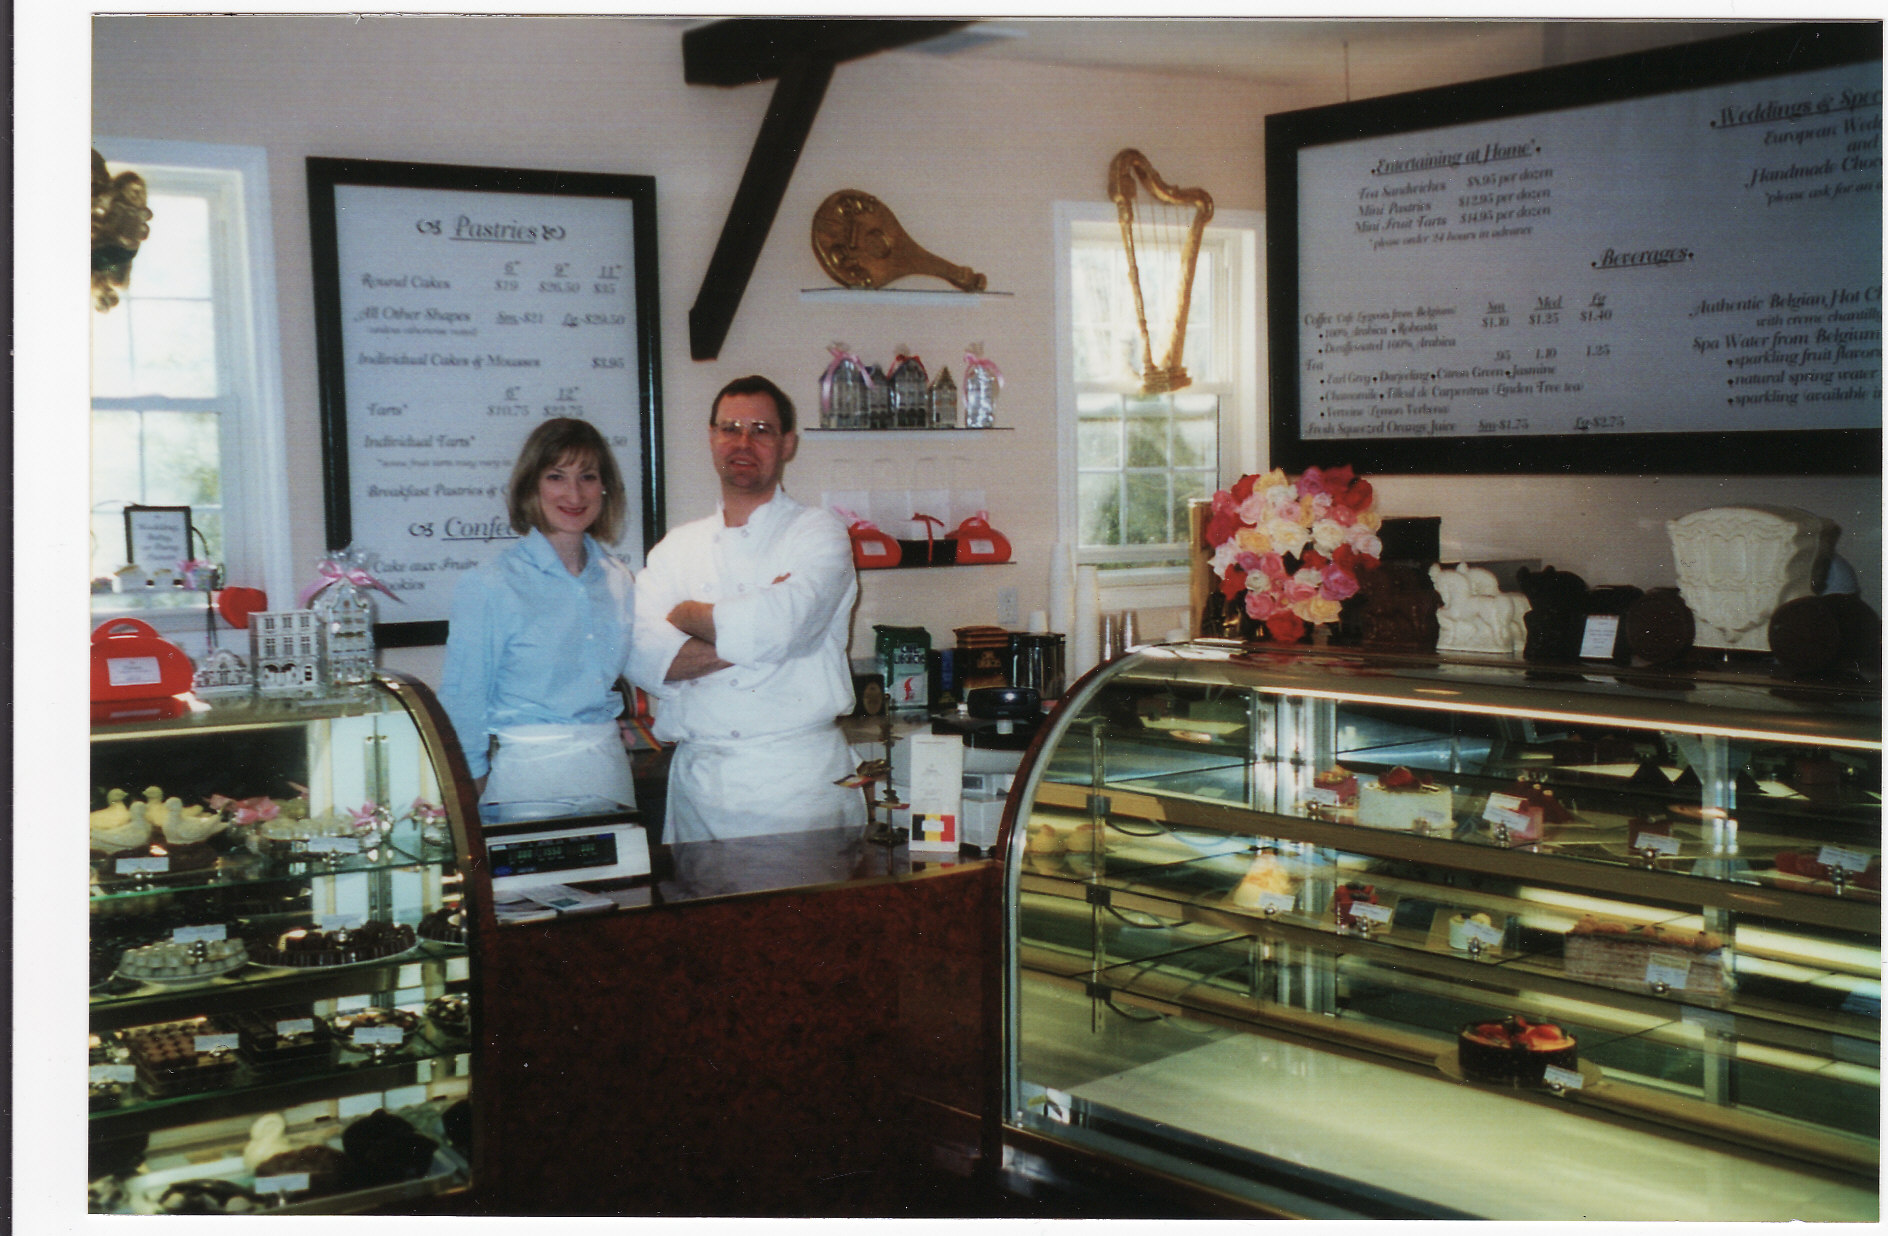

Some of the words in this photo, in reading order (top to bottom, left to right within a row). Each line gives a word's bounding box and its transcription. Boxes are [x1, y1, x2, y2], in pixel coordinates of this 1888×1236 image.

[1720, 101, 1812, 124] Weddings
[1764, 127, 1837, 146] European
[1847, 133, 1879, 152] and
[1375, 150, 1463, 173] Entertaining
[1465, 148, 1481, 163] at
[1745, 159, 1838, 189] Handmade
[1358, 187, 1379, 200] Tea
[1382, 179, 1447, 197] Sandwiches
[1498, 172, 1516, 187] per
[1519, 167, 1553, 182] dozen
[1807, 184, 1831, 199] ask
[1831, 182, 1854, 199] for
[1358, 204, 1384, 216] Mini
[1388, 201, 1432, 214] Pastries
[1458, 194, 1494, 207] $12.95
[1495, 192, 1515, 206] per
[1516, 187, 1551, 200] dozen
[455, 214, 538, 241] Pastries
[1356, 222, 1380, 233] Mini
[1383, 218, 1413, 230] Fruit
[1416, 214, 1447, 227] Tarts
[1459, 211, 1494, 224] $14.95
[1495, 209, 1515, 223] per
[1516, 205, 1551, 218] dozen
[1446, 231, 1477, 242] hours
[1601, 248, 1688, 267] Beverages
[361, 272, 408, 288] Round
[411, 275, 451, 288] Cakes
[1534, 294, 1563, 311] Med
[1688, 296, 1764, 319] Authentic
[1770, 293, 1826, 311] Belgian
[1826, 288, 1860, 308] Hot
[382, 307, 421, 320] Other
[425, 308, 471, 323] Shapes
[1304, 312, 1332, 328] Coffee
[1528, 312, 1559, 325] $1.25
[1579, 309, 1613, 322] $1.40
[1756, 314, 1784, 327] with
[1692, 336, 1720, 354] Spa
[1725, 333, 1770, 349] Water
[1772, 330, 1809, 350] from
[1815, 327, 1881, 344] Belgium
[358, 352, 428, 366] Individual
[430, 353, 469, 366] Cakes
[1304, 359, 1324, 371] Tea
[1735, 350, 1799, 368] sparkling
[1798, 347, 1832, 366] fruit
[1472, 366, 1504, 378] Green
[1510, 363, 1556, 379] Jasmine
[1735, 370, 1785, 385] natural
[1788, 369, 1835, 386] spring
[1838, 369, 1879, 380] water
[1735, 389, 1799, 407] sparkling
[364, 434, 432, 448] Individual
[368, 484, 430, 500] Breakfast
[433, 483, 484, 497] Pastries
[373, 558, 406, 573] Cake
